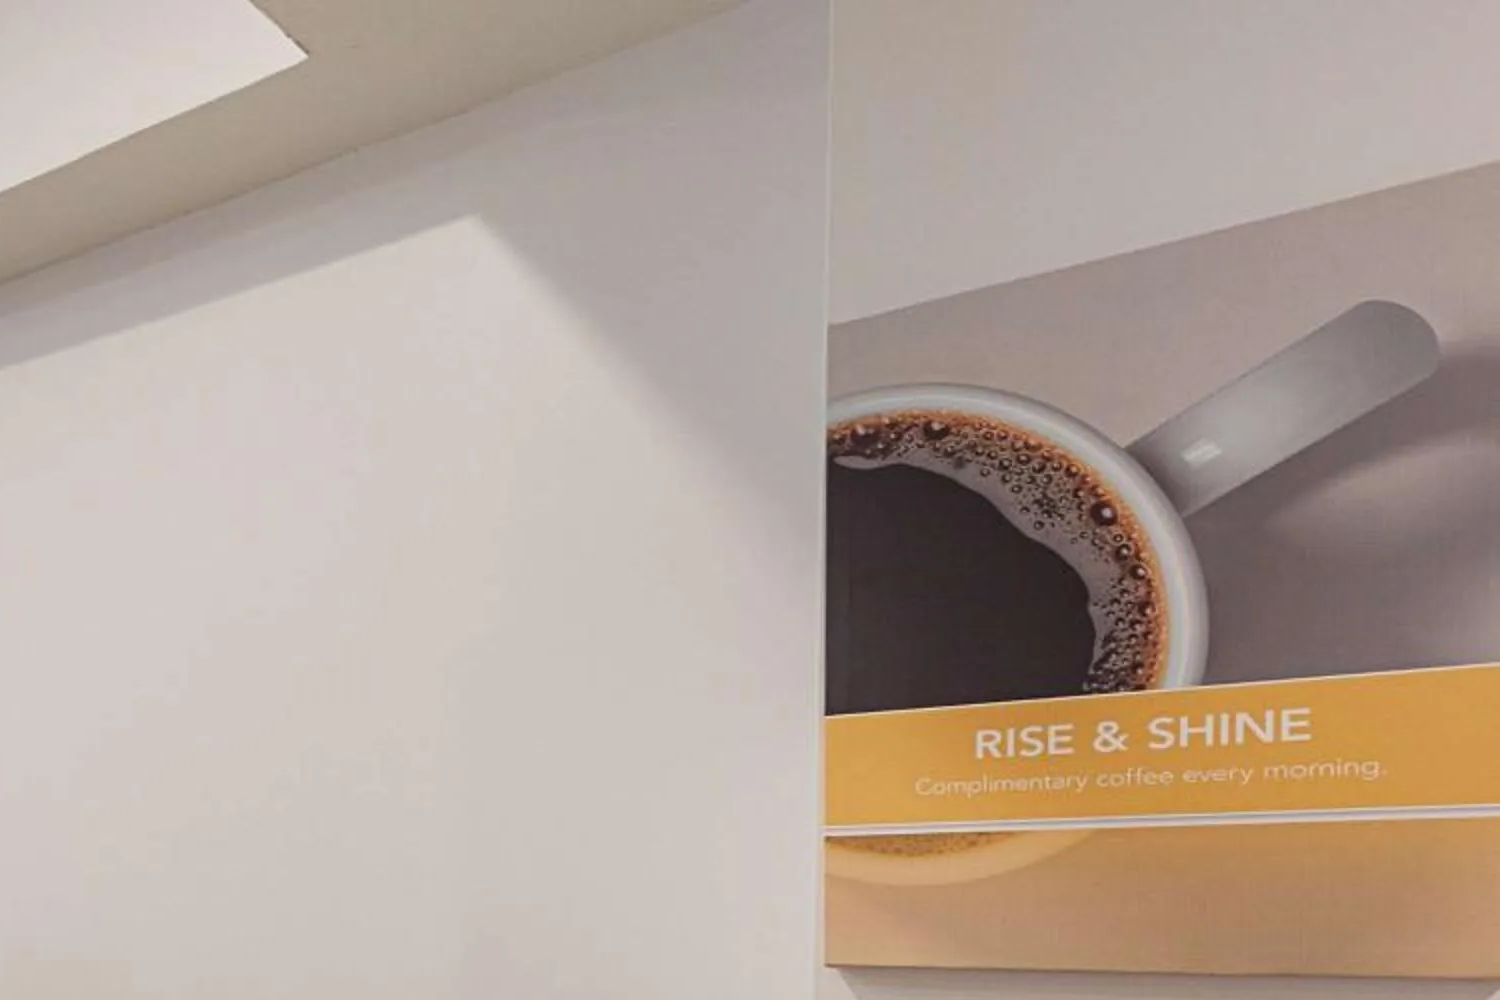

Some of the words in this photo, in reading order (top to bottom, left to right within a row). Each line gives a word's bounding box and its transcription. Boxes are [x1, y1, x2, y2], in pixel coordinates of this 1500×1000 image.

[974, 722, 1075, 760] RISE
[1092, 720, 1129, 754] &
[1146, 707, 1313, 750] SHINE
[914, 772, 1088, 799] Complimentary
[1096, 767, 1175, 788] coffee
[1182, 766, 1254, 786] every
[1263, 757, 1388, 781] morning.
